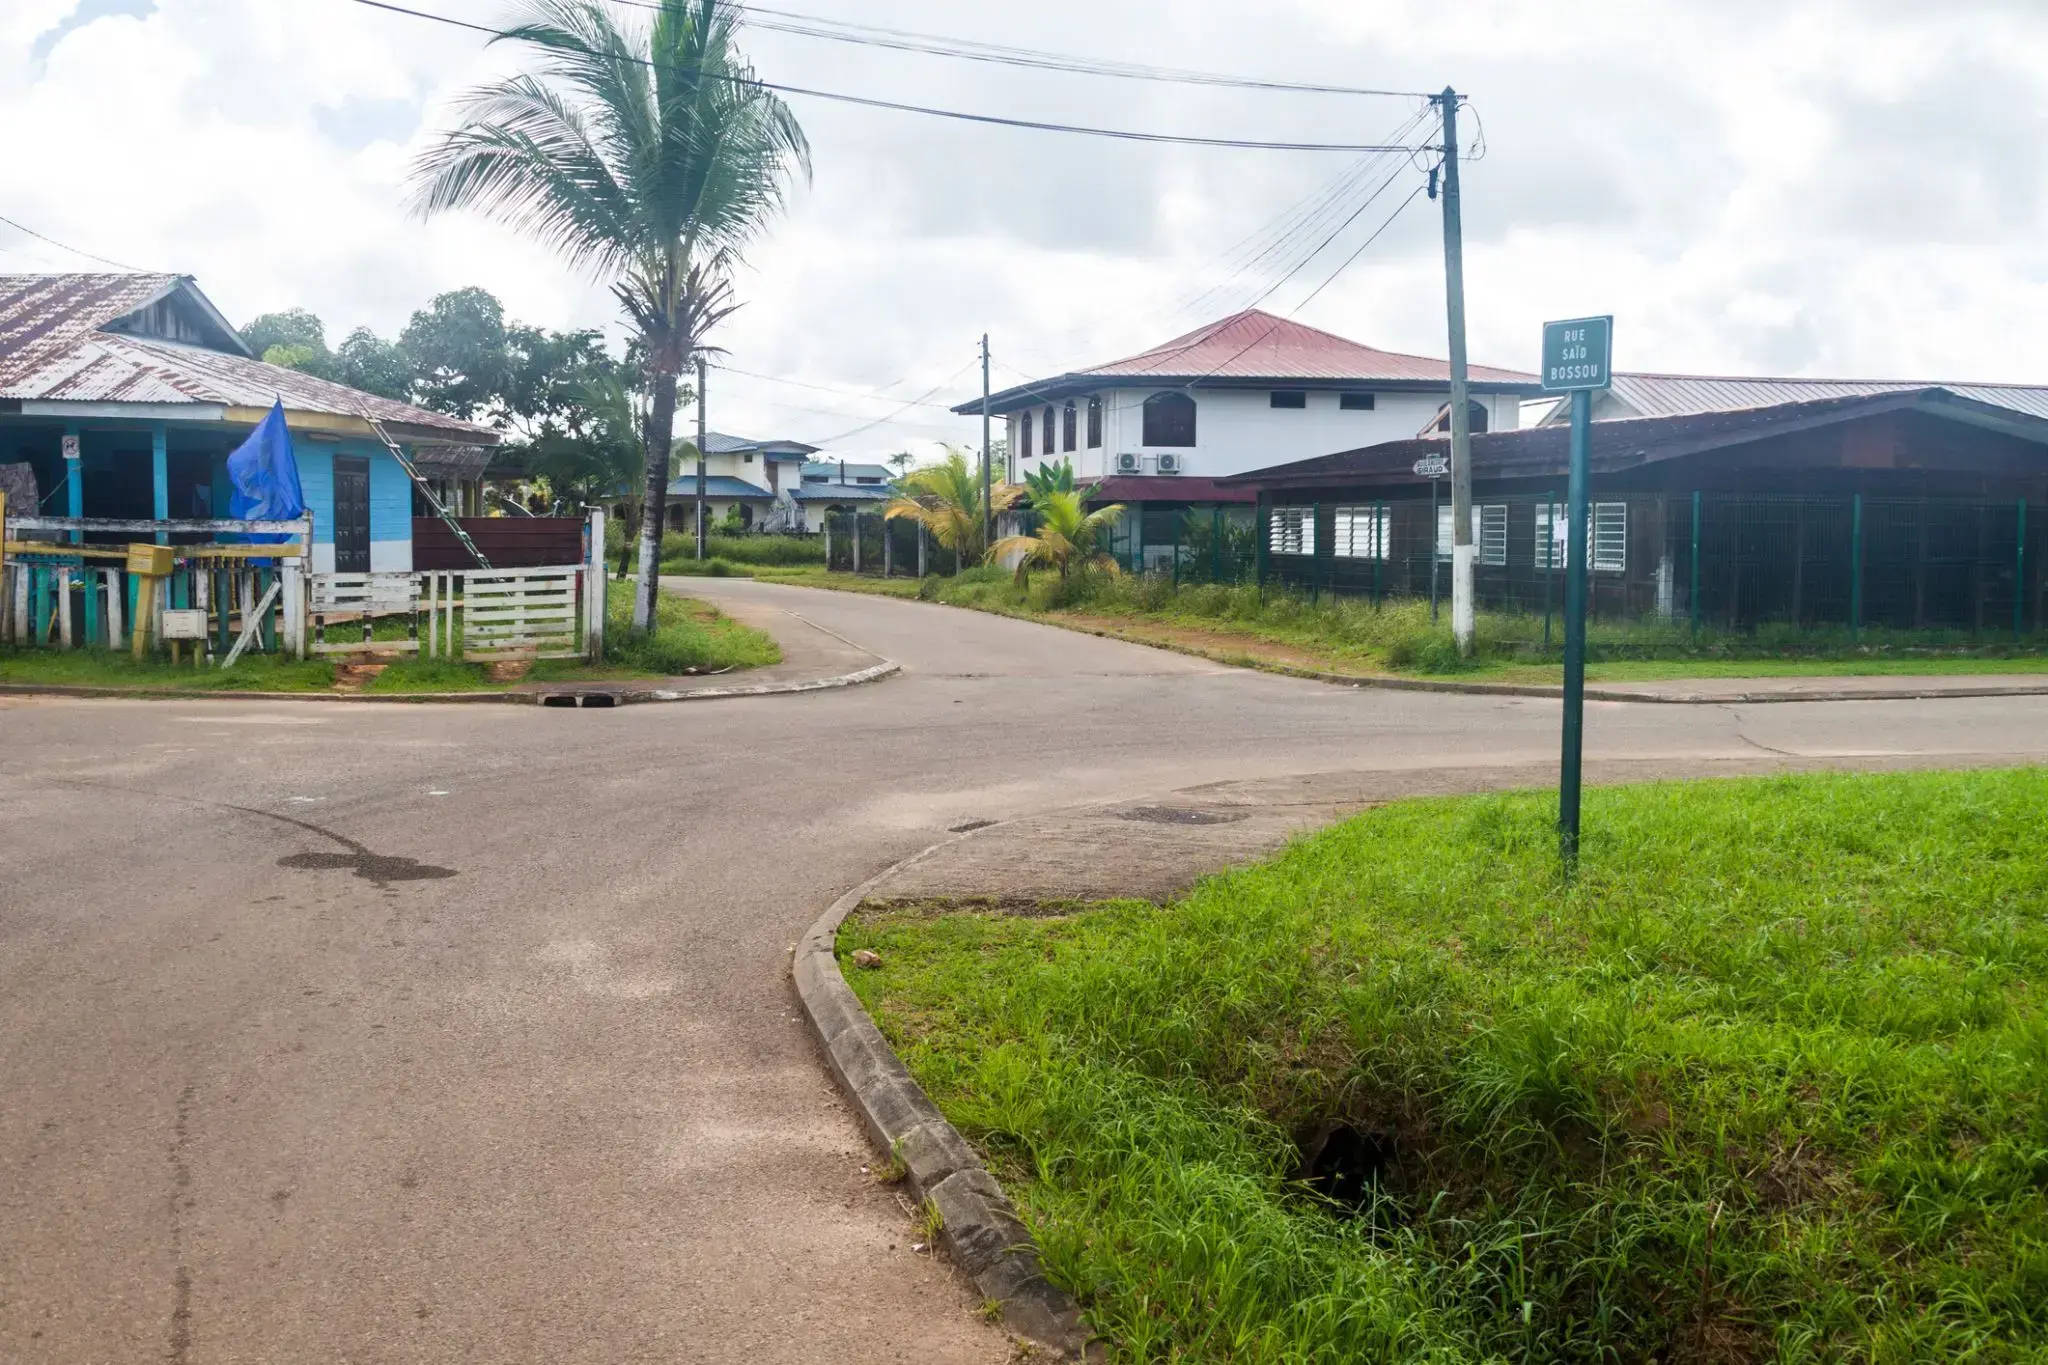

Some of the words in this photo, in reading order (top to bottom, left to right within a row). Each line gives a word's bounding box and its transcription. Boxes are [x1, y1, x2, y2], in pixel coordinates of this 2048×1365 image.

[1564, 329, 1585, 342] RUE
[1562, 345, 1587, 360] SAÏD
[1551, 364, 1598, 380] BOSSOU
